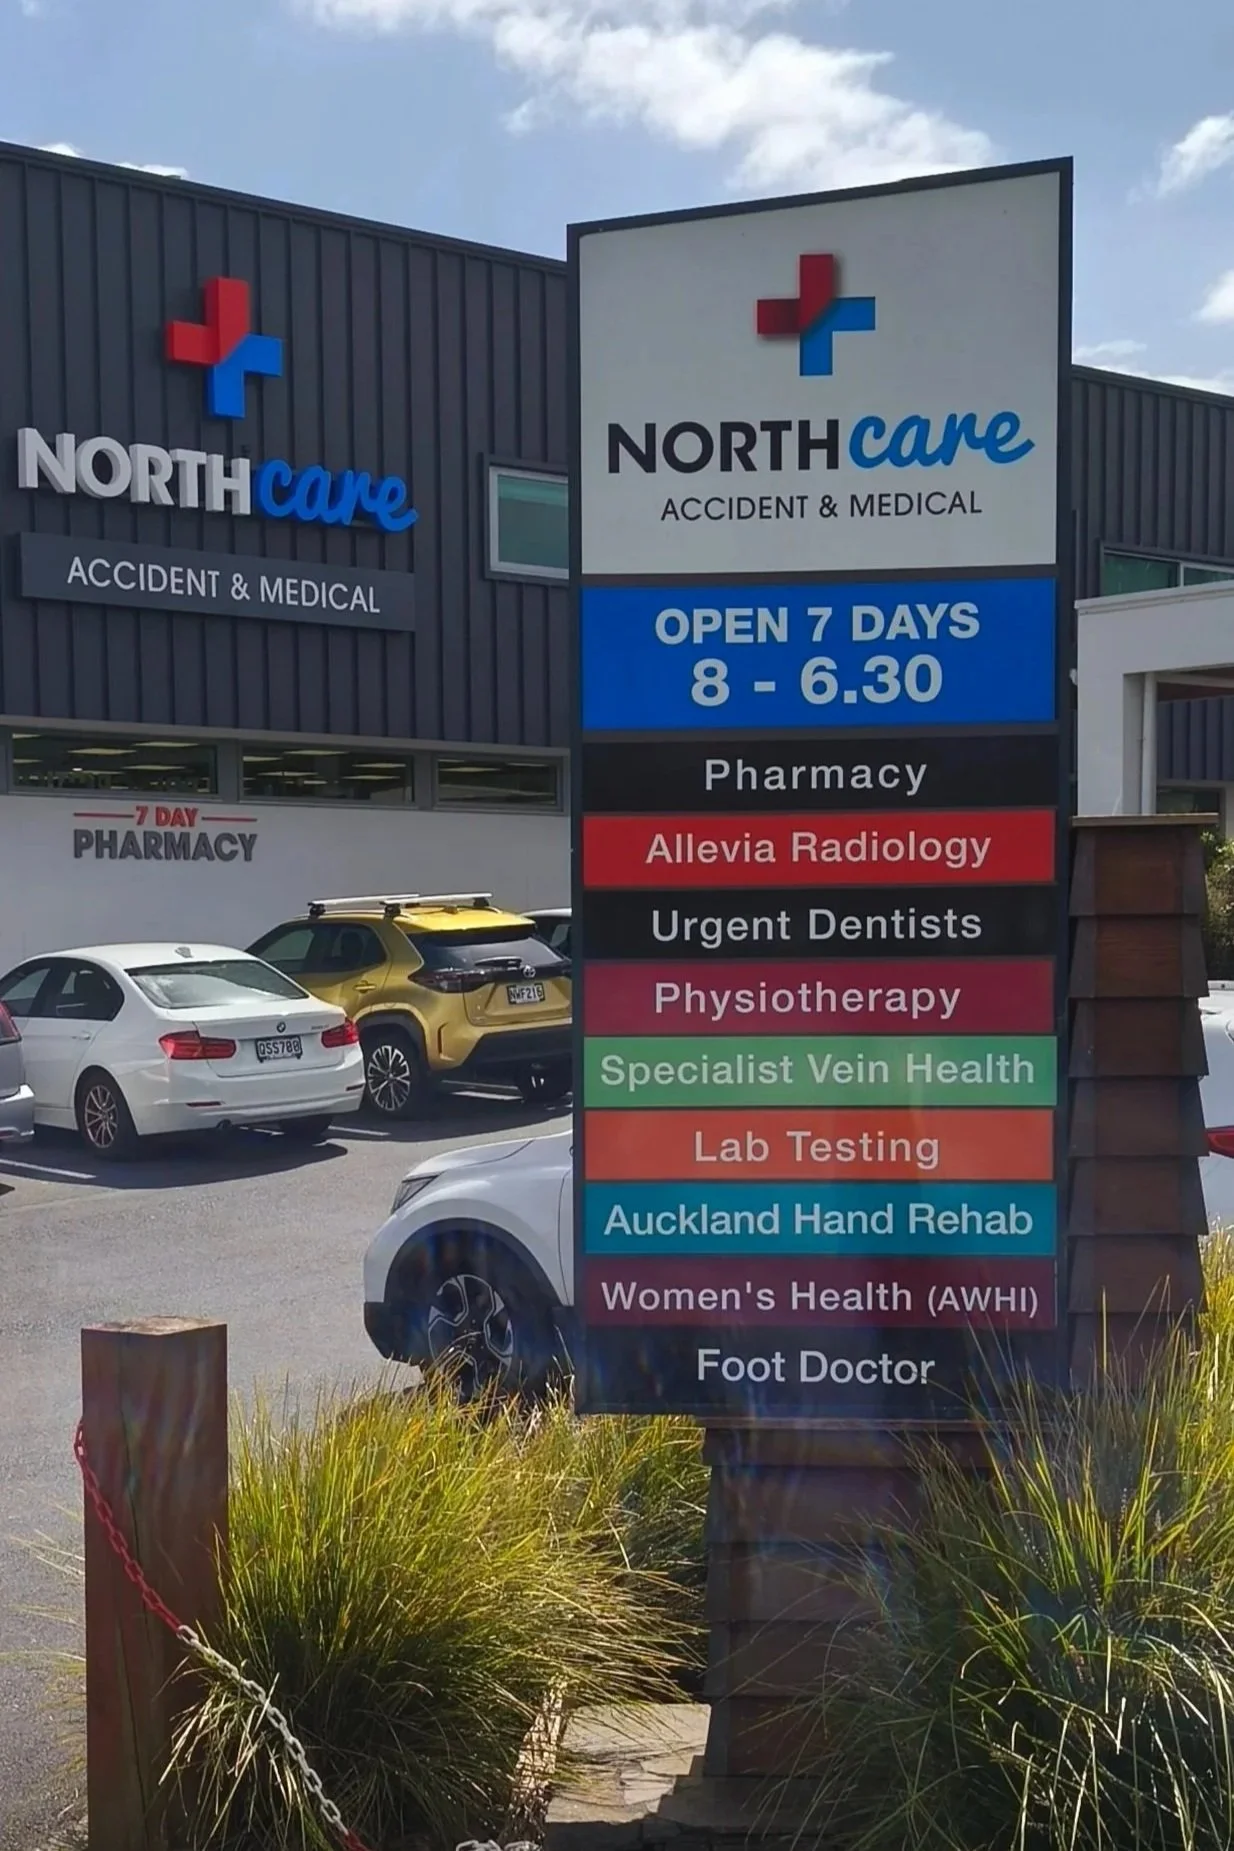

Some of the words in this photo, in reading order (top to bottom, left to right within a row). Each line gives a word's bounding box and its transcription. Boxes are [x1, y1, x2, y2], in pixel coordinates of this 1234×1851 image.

[661, 496, 808, 521] ACCIDENT
[819, 495, 837, 518] &
[851, 491, 982, 517] MEDICAL
[67, 556, 220, 598] ACCIDENT
[231, 572, 251, 601] &
[260, 576, 381, 613] MEDICAL
[655, 607, 787, 645] OPEN
[807, 607, 832, 641] 7
[852, 602, 980, 640] DAYS
[690, 658, 730, 706] 8
[753, 681, 776, 692] -
[801, 654, 943, 704] 6.30
[705, 759, 927, 797] Pharmacy
[135, 805, 149, 826] 7
[155, 806, 199, 828] DAY
[73, 829, 258, 862] PHARMACY
[645, 832, 776, 864] Allevia
[792, 831, 992, 869] Radiology
[652, 910, 790, 949] Urgent
[809, 908, 982, 940] Dentists
[655, 982, 961, 1022] Physiotherapy
[601, 1053, 793, 1091] Specialist
[807, 1053, 888, 1084] Vein
[906, 1053, 1034, 1084] Health
[695, 1131, 769, 1163] Lab
[786, 1131, 939, 1170] Testing
[604, 1204, 780, 1236] Auckland
[794, 1203, 893, 1235] Hand
[909, 1203, 1033, 1235] Rehab
[601, 1281, 775, 1311] Women's
[791, 1281, 911, 1311] Health
[928, 1285, 1038, 1319] (AWHI)
[697, 1348, 786, 1383] Foot
[799, 1350, 936, 1385] Doctor
